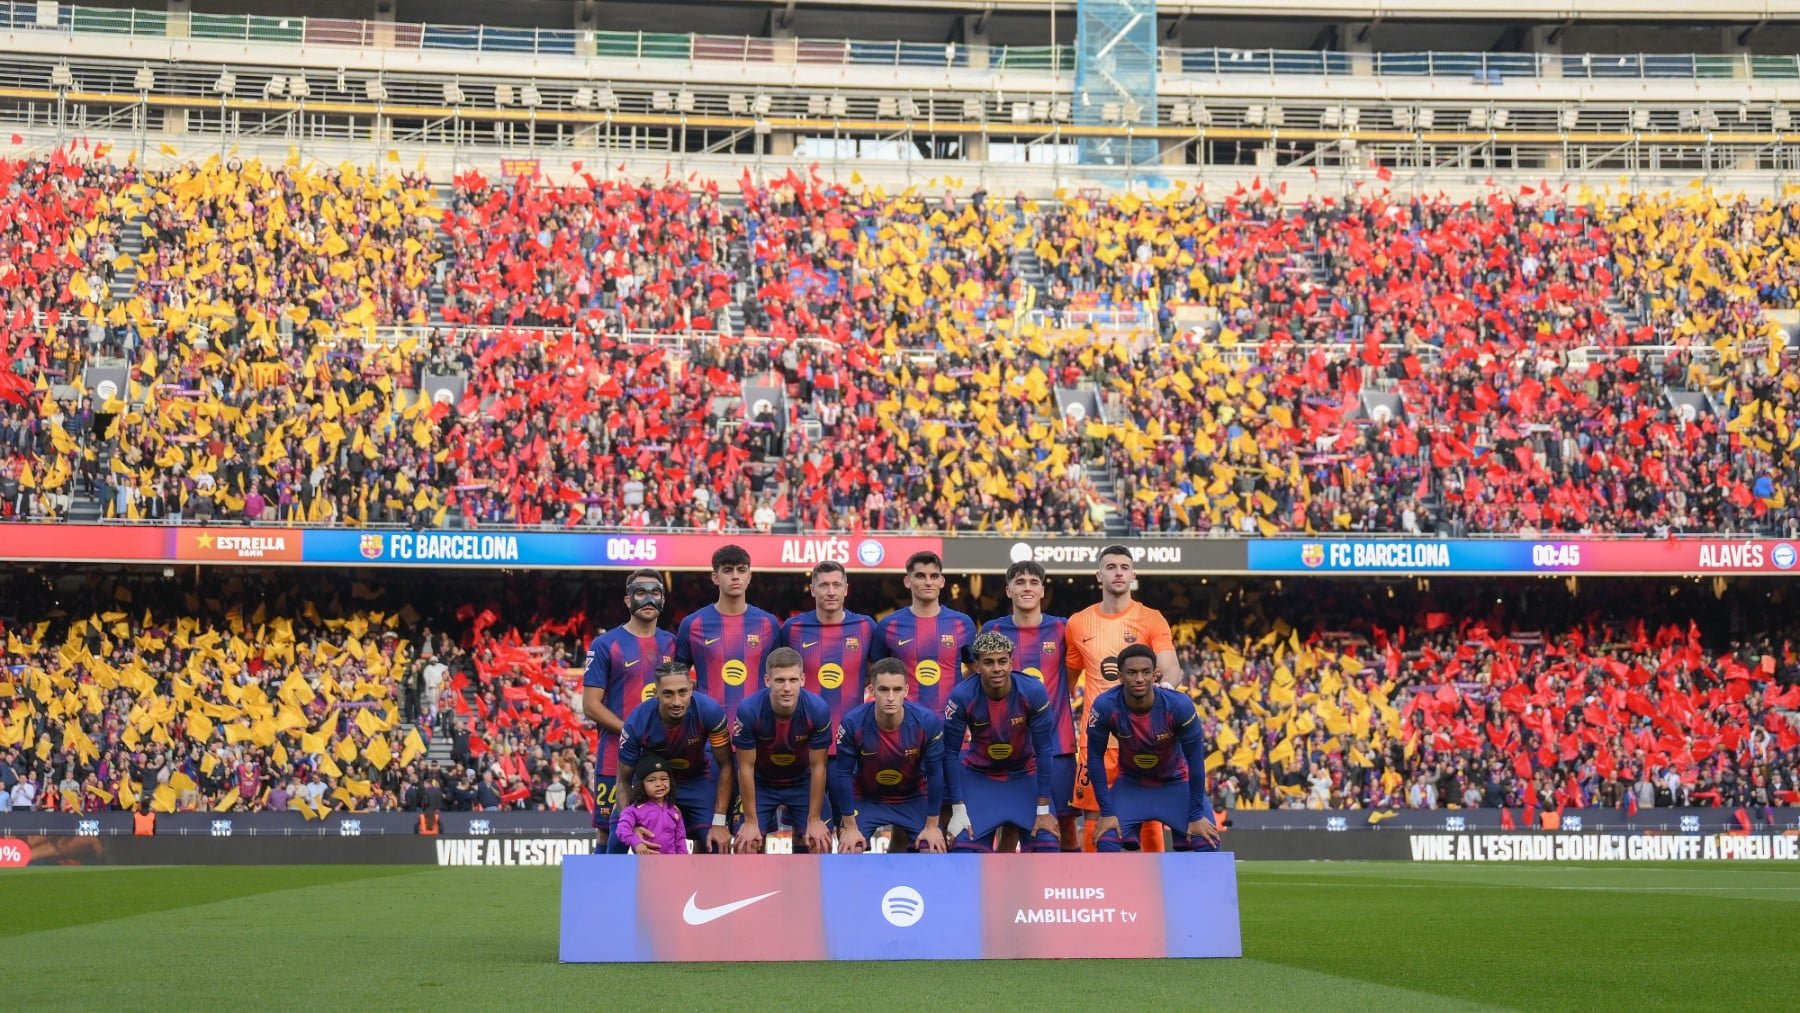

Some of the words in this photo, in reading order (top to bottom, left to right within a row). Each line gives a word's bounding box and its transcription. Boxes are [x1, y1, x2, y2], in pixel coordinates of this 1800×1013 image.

[216, 536, 285, 550] ESTRELLA
[390, 535, 413, 559] FC
[416, 535, 519, 560] BARCELONA
[607, 538, 657, 560] 00:45
[781, 536, 850, 563] ALAVÉS
[1033, 546, 1099, 562] SPOTIFY
[1147, 547, 1181, 562] NOU
[1699, 541, 1764, 567] ALAVÉS
[1330, 543, 1351, 567] FC
[1353, 543, 1450, 567] BARCELONA
[1533, 544, 1580, 566] 00:45
[436, 839, 484, 866] VINE
[485, 839, 501, 866] A
[1410, 835, 1456, 861] VINE
[1457, 835, 1472, 861] A
[1473, 835, 1554, 861] L'ESTADI
[1628, 835, 1700, 860] CRUYFF
[1703, 835, 1718, 860] A
[1719, 835, 1771, 860] PREU
[1772, 835, 1799, 860] DE
[1044, 887, 1105, 900] PHILIPS
[1014, 909, 1116, 923] AMBILIGHT
[1120, 909, 1138, 923] tv
